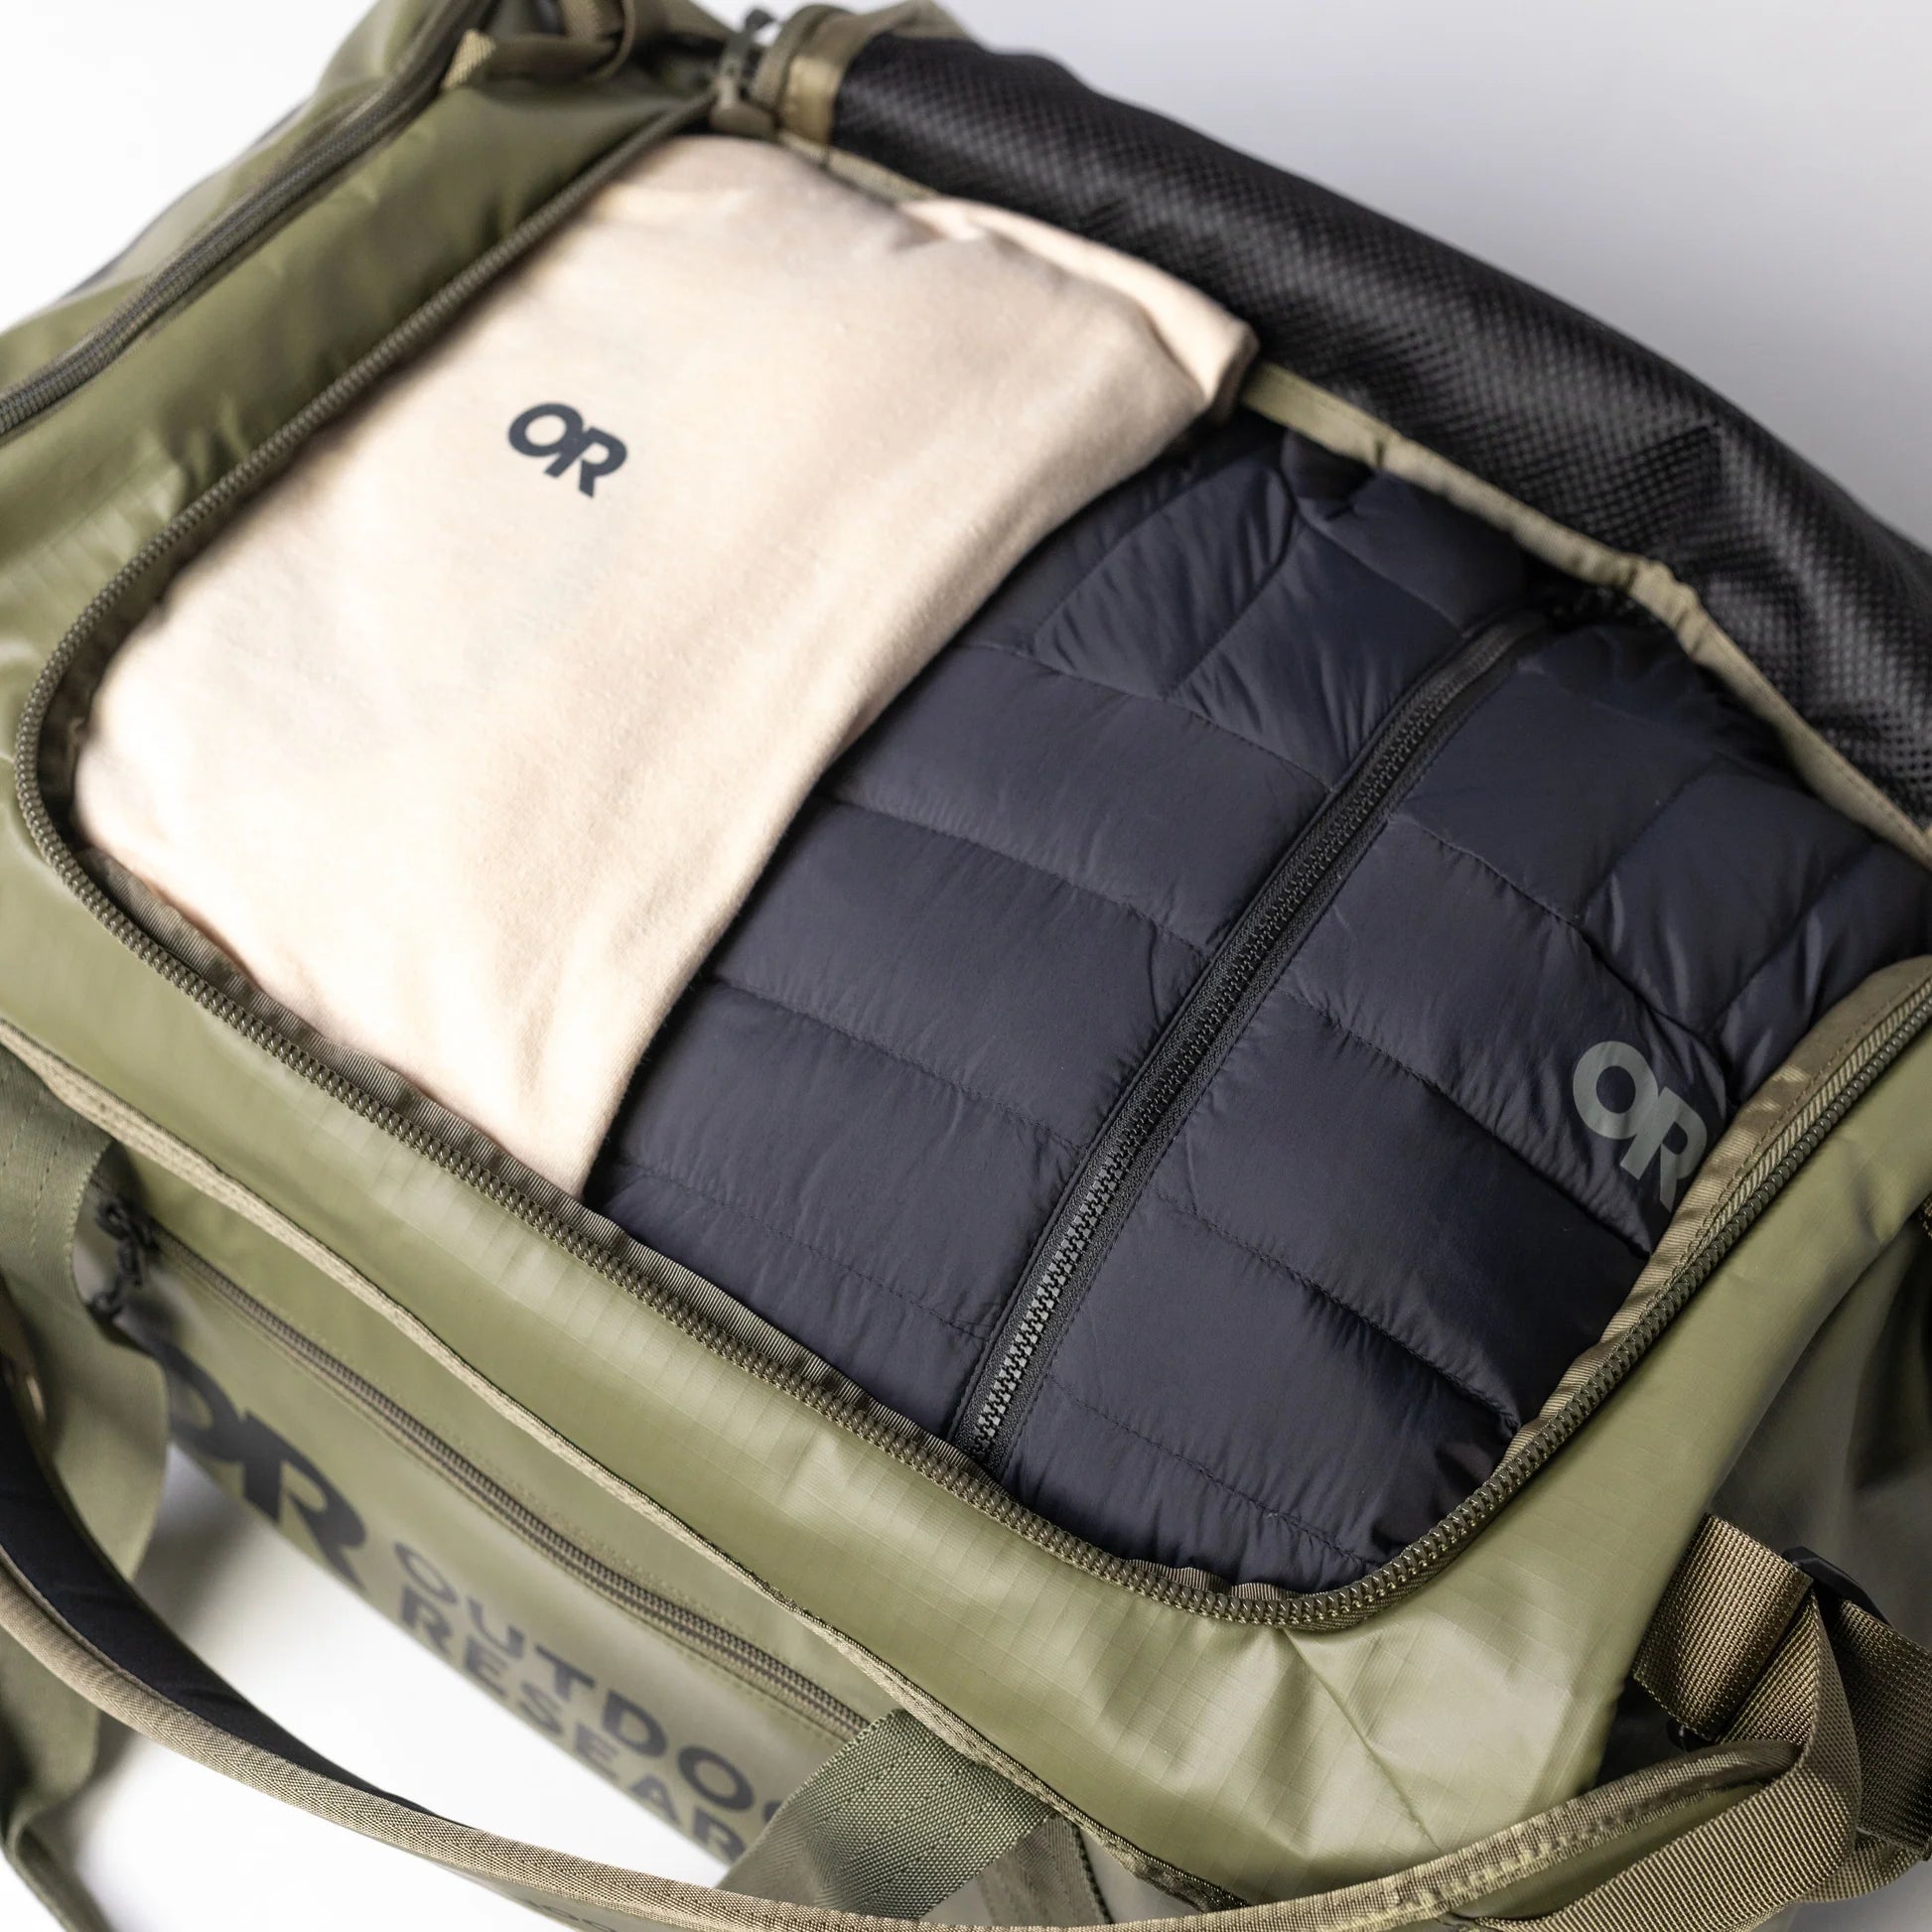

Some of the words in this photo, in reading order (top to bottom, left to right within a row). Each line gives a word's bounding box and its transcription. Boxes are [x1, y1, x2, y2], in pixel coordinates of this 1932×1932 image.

[507, 402, 627, 498] OR
[1573, 1040, 1708, 1214] OR
[395, 1542, 782, 1823] OUTDO
